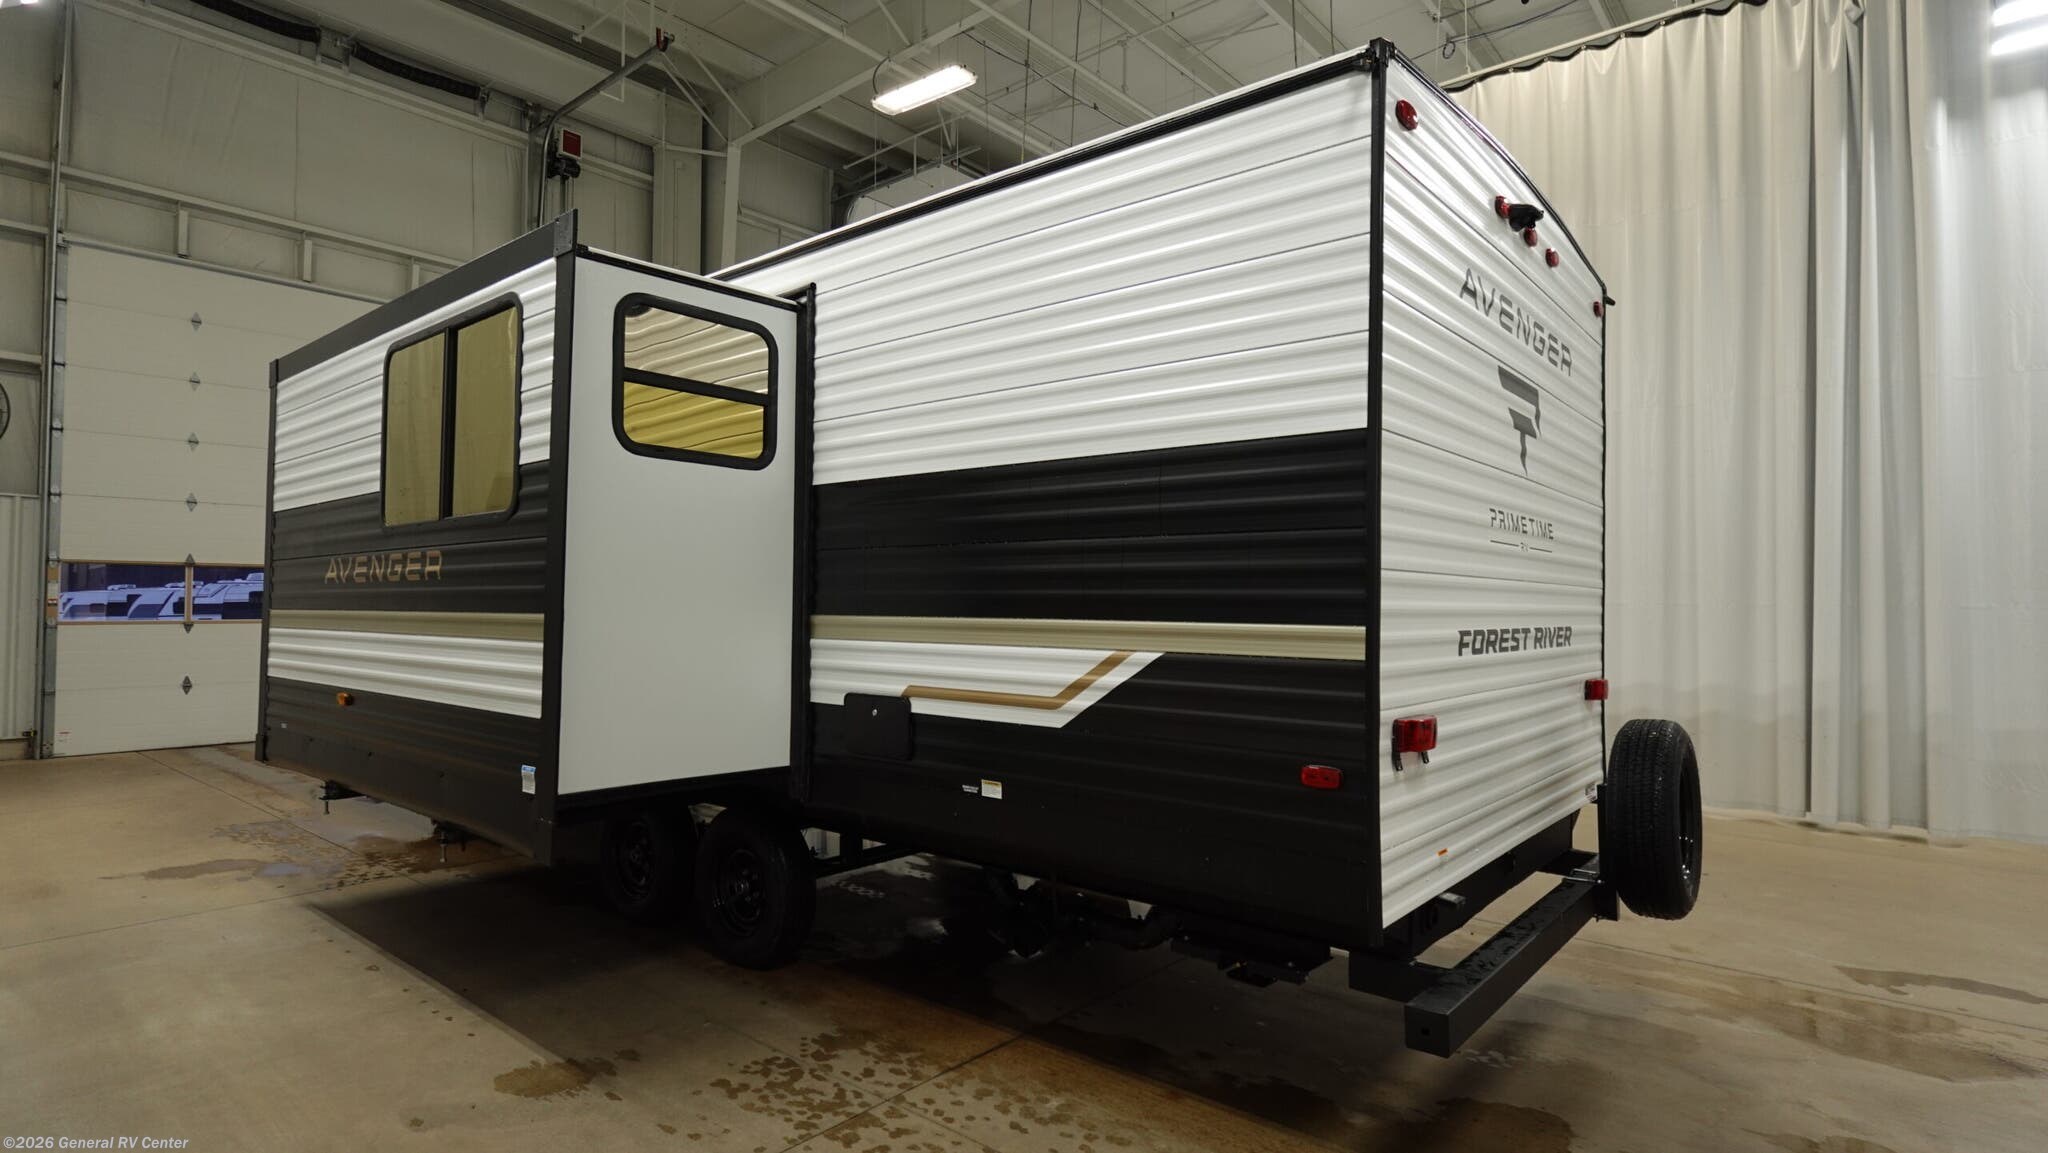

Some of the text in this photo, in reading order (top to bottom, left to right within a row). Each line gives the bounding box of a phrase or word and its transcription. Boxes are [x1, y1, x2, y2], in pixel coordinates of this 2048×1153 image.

[1460, 268, 1572, 376] AVENGER
[325, 550, 443, 584] AVENGER
[1458, 626, 1573, 657] FOREST RIVER
